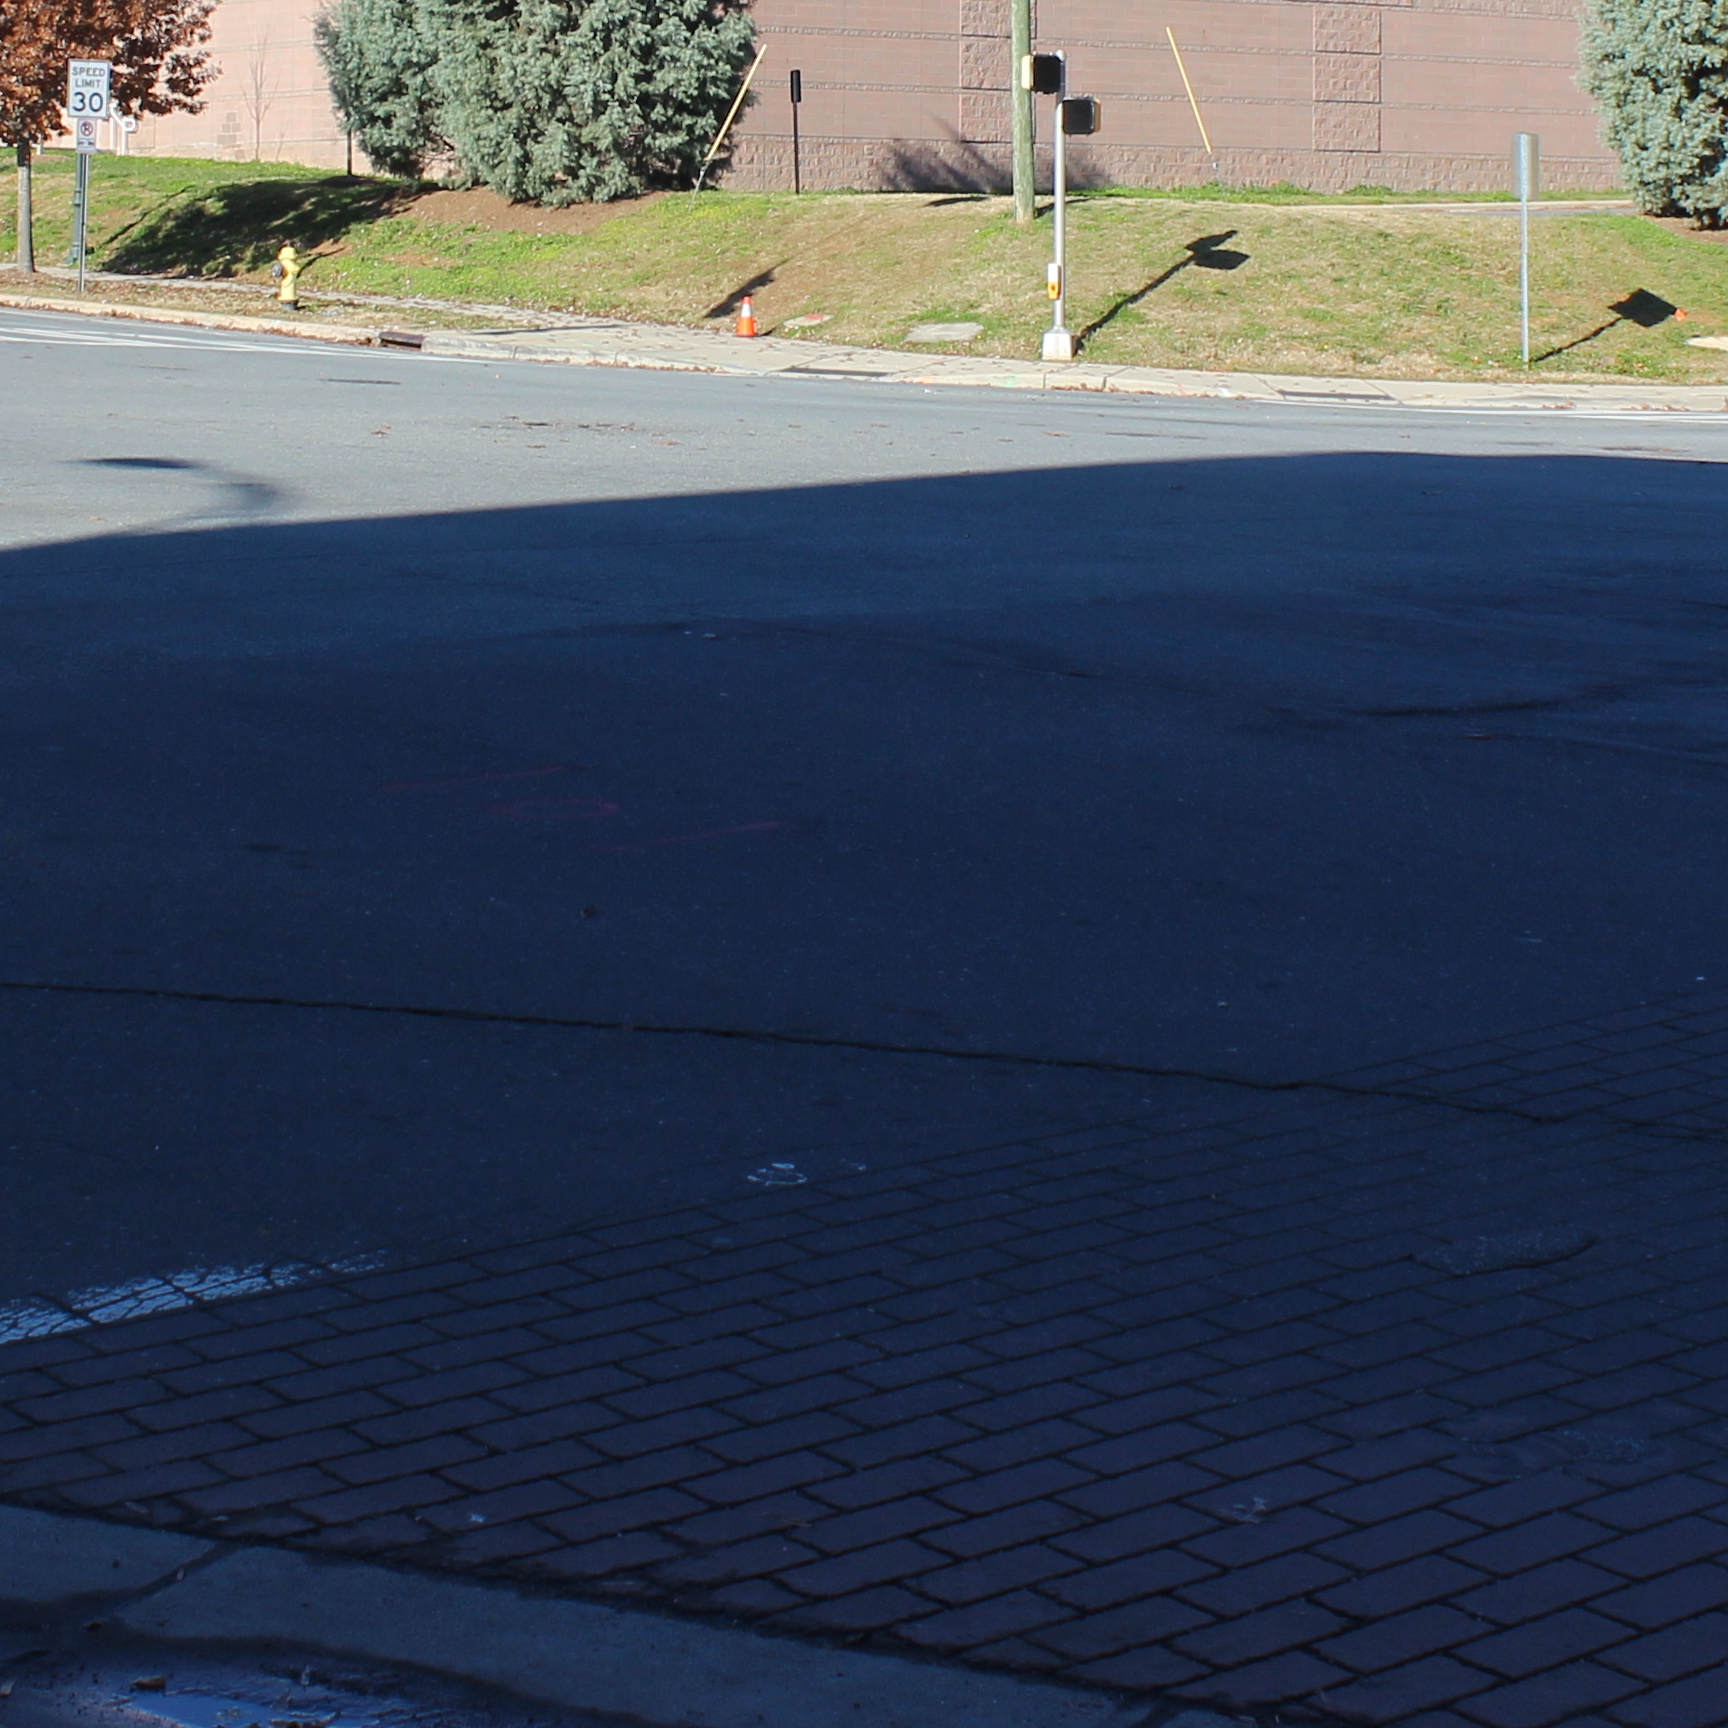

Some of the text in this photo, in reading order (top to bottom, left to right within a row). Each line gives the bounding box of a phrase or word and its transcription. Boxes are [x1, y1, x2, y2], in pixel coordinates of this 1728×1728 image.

[72, 66, 106, 77] SPEED
[74, 78, 102, 89] LIMIT
[72, 91, 104, 113] 30
